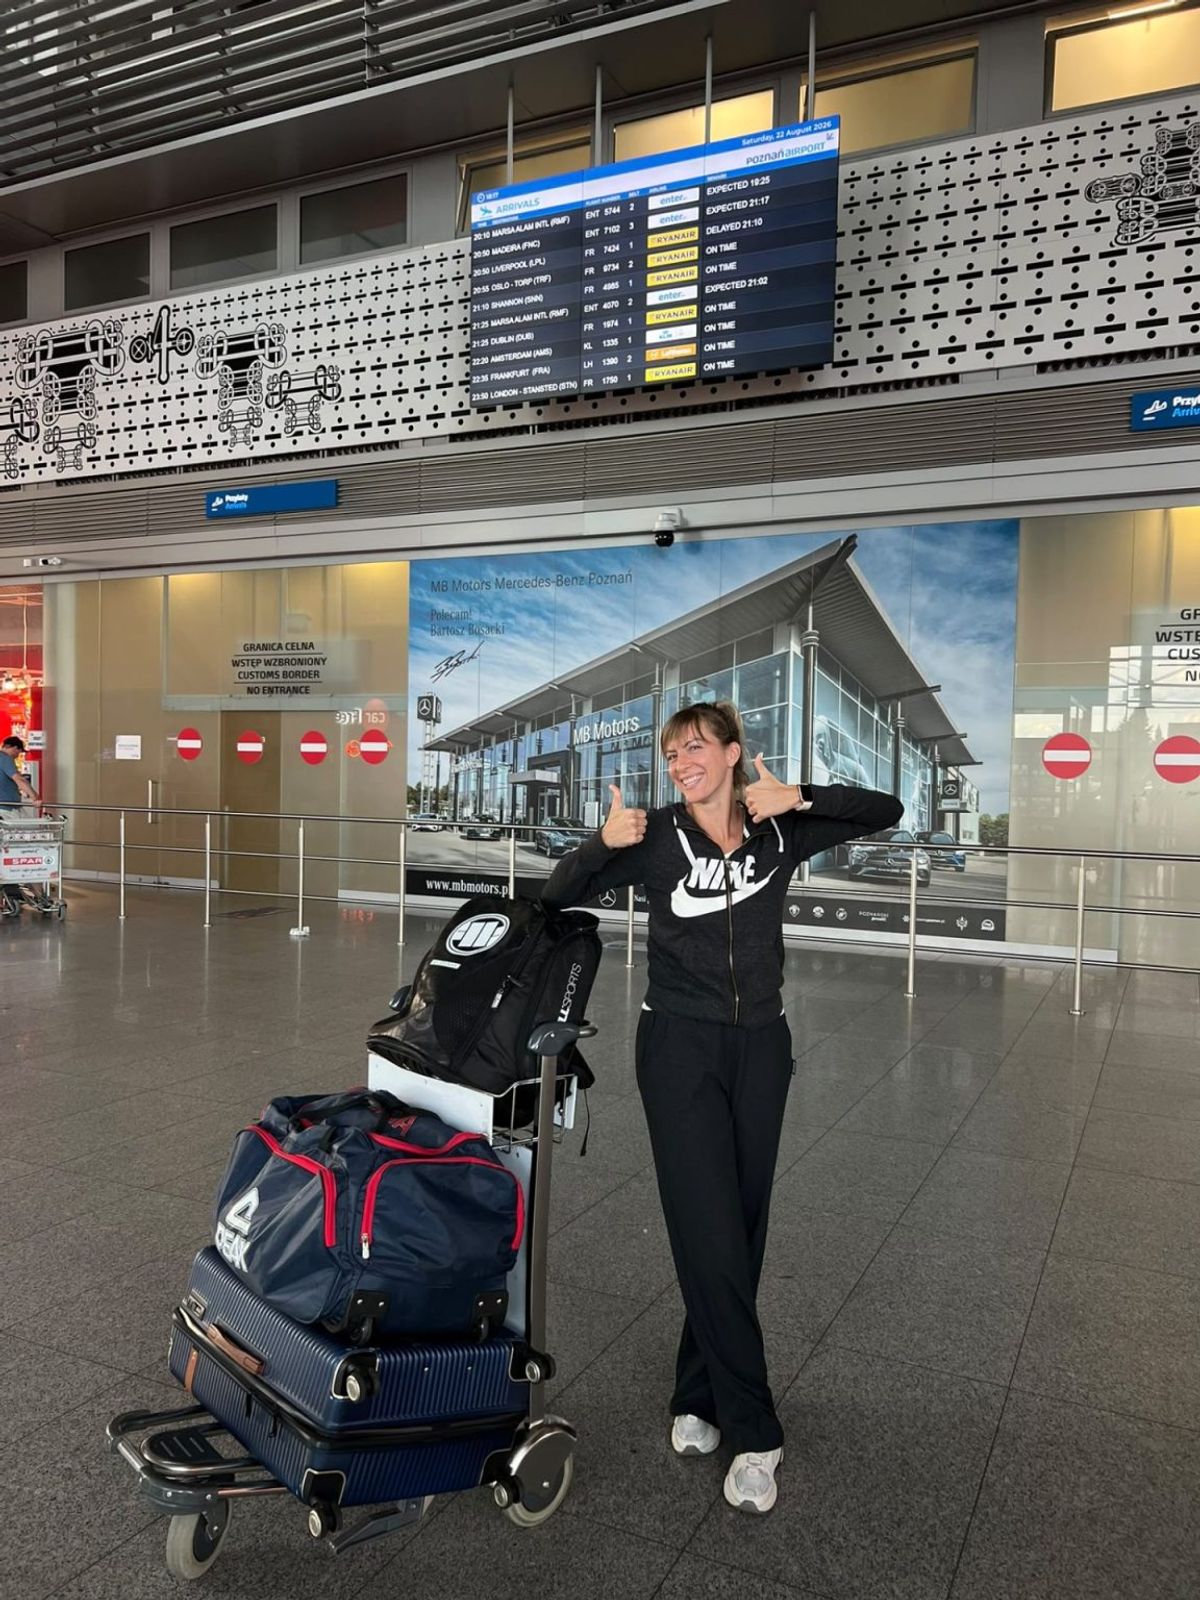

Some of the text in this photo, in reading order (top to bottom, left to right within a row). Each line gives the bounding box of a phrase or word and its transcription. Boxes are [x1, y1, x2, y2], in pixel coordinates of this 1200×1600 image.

[742, 120, 832, 147] Saturday, 22 August 2026
[474, 230, 490, 241] 20:10
[535, 219, 549, 229] INTL
[550, 214, 570, 227] (RMF)
[585, 209, 600, 219] ENT
[604, 205, 620, 215] 5744
[629, 202, 634, 210] 2
[707, 180, 748, 196] EXPECTED
[496, 197, 540, 214] ARRIVALS
[473, 248, 490, 259] 20:50
[492, 242, 521, 255] MADEIRA
[522, 238, 540, 250] (FNC)
[585, 227, 599, 238] ENT
[604, 223, 620, 234] 7102
[629, 221, 634, 230] 3
[706, 199, 748, 215] EXPECTED
[749, 195, 769, 207] 21:17
[473, 266, 490, 277] 20:50
[491, 259, 528, 273] LIVERPOOL
[529, 256, 546, 267] (LPL)
[585, 247, 595, 257] FR
[629, 240, 633, 249] 1
[657, 230, 695, 244] RYANAIR
[706, 221, 741, 235] DELAYED
[742, 217, 762, 229] 21:10
[473, 284, 489, 294] 20:55
[491, 281, 510, 291] OSLO
[514, 277, 533, 287] TORP
[533, 273, 551, 285] (TRF)
[584, 266, 594, 275] FR
[628, 259, 633, 267] 2
[657, 249, 695, 263] RYANAIR
[706, 244, 717, 254] ON
[719, 241, 737, 252] TIME
[473, 302, 489, 312] 21:10
[491, 296, 523, 309] SHANNON
[524, 293, 543, 304] (SNN)
[584, 284, 594, 293] FR
[629, 278, 632, 286] 1
[656, 268, 695, 282] RYANAIR
[705, 264, 717, 274] ON
[718, 261, 736, 271] TIME
[472, 320, 489, 330] 21:25
[533, 310, 548, 320] INTL
[549, 307, 568, 318] (RMF)
[584, 302, 598, 312] ENT
[602, 299, 619, 309] 4070
[628, 297, 633, 305] 2
[705, 279, 746, 293] EXPECTED
[748, 275, 768, 286] 21:02
[472, 300, 736, 348] 21:25 DUBLIN (DUB) FR 1974 1 RYANAIR ON TIME
[472, 356, 489, 365] 22:20
[490, 349, 532, 363] AMSTERDAM
[533, 346, 552, 358] (AMS)
[584, 341, 592, 349] KL
[603, 337, 618, 347] 1335
[628, 335, 631, 343] 1
[704, 323, 716, 332] ON
[717, 320, 735, 330] TIME
[490, 368, 530, 381] FRANKFURT
[532, 365, 550, 376] (FRA)
[583, 359, 593, 368] LH
[627, 354, 632, 362] 2
[704, 342, 716, 352] ON
[717, 339, 735, 350] TIME
[490, 387, 518, 399] LONDON
[523, 382, 558, 394] STANSTED
[558, 379, 577, 391] (STN)
[583, 378, 593, 387] FR
[627, 373, 631, 381] 1
[655, 365, 693, 377] RYANAIR
[703, 361, 715, 371] ON
[716, 359, 735, 369] TIME
[431, 569, 633, 592] MB Motors Mercedes-Benz Poznań
[430, 609, 472, 621] Polecam!
[430, 624, 465, 636] Bartosz
[243, 642, 315, 652] GRANICA CELNA
[232, 657, 327, 668] WSTĘP WZBRONIONY
[238, 670, 320, 680] CUSTOMS BORDER
[1185, 670, 1200, 682] N
[247, 686, 310, 695] NO ENTRANCE
[574, 726, 590, 744] MB
[594, 716, 640, 739] Motors
[687, 855, 755, 890] NIKE
[426, 879, 510, 898] www.mbmotors.p
